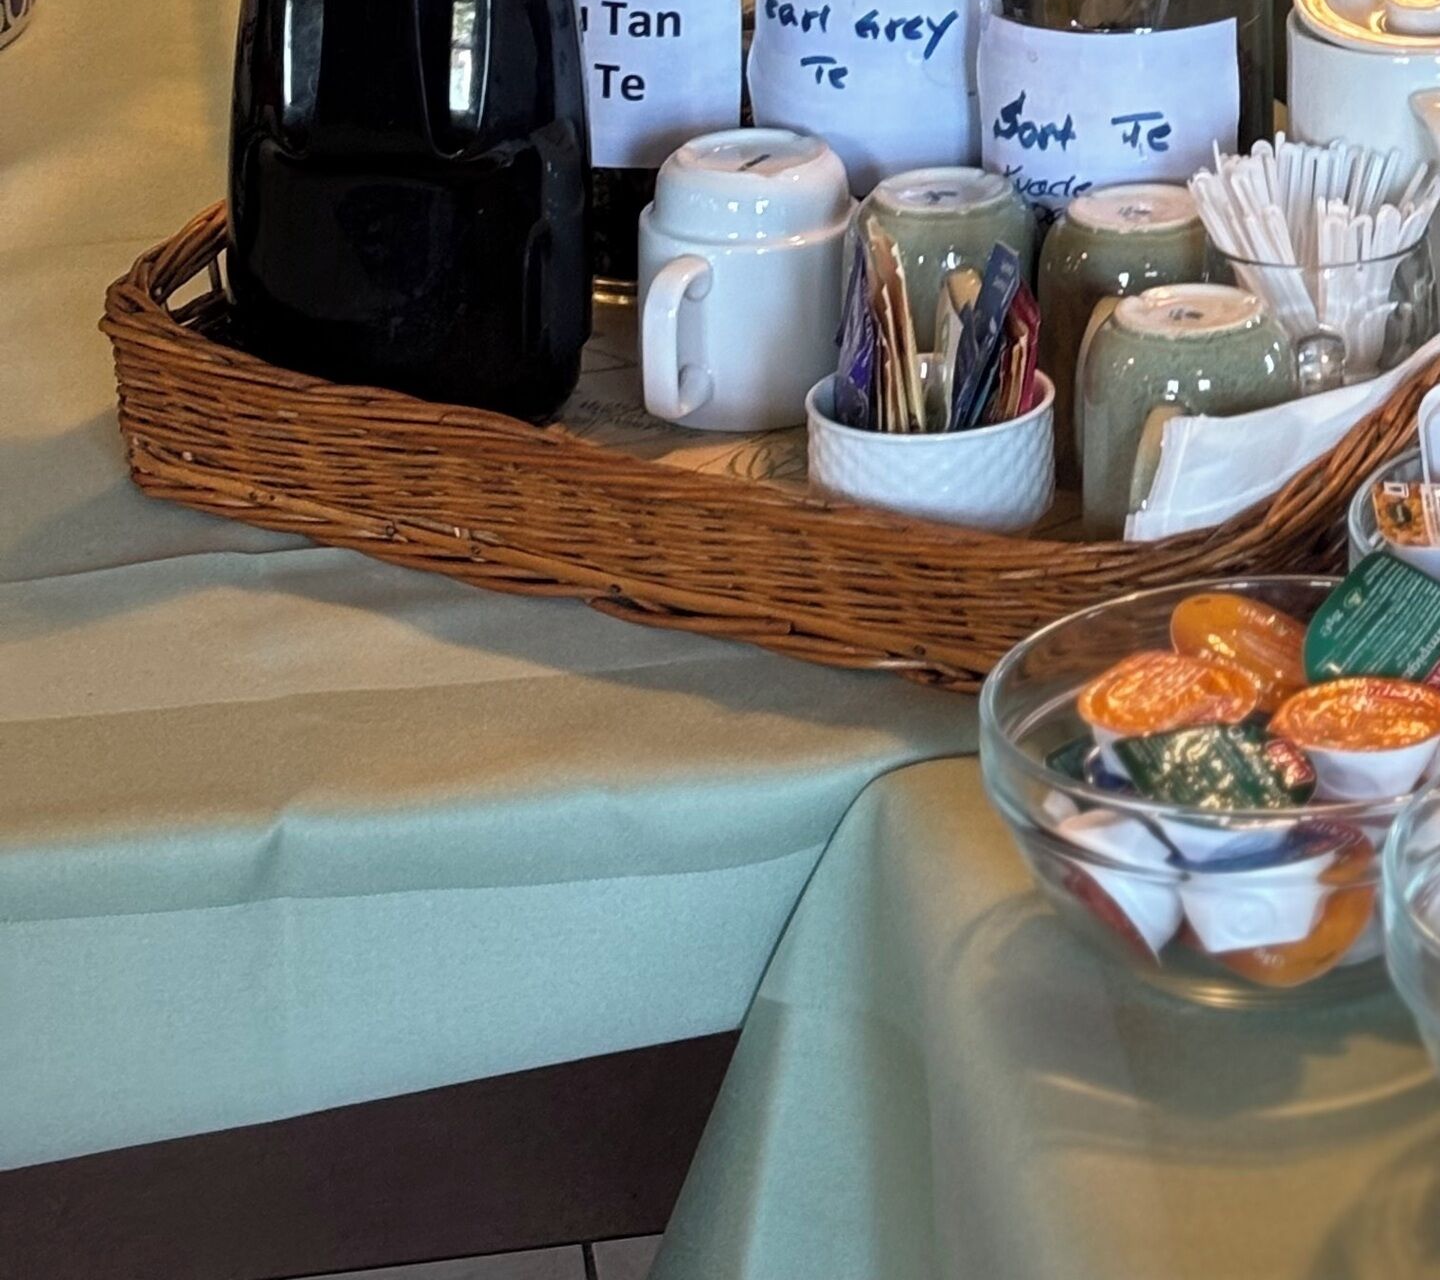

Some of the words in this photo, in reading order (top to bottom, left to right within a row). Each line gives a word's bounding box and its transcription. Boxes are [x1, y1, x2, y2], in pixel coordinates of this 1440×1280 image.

[601, 1, 681, 38] Tan
[855, 9, 959, 60] Grey
[594, 63, 645, 101] Te
[800, 55, 848, 89] Te
[1111, 111, 1172, 152] Te
